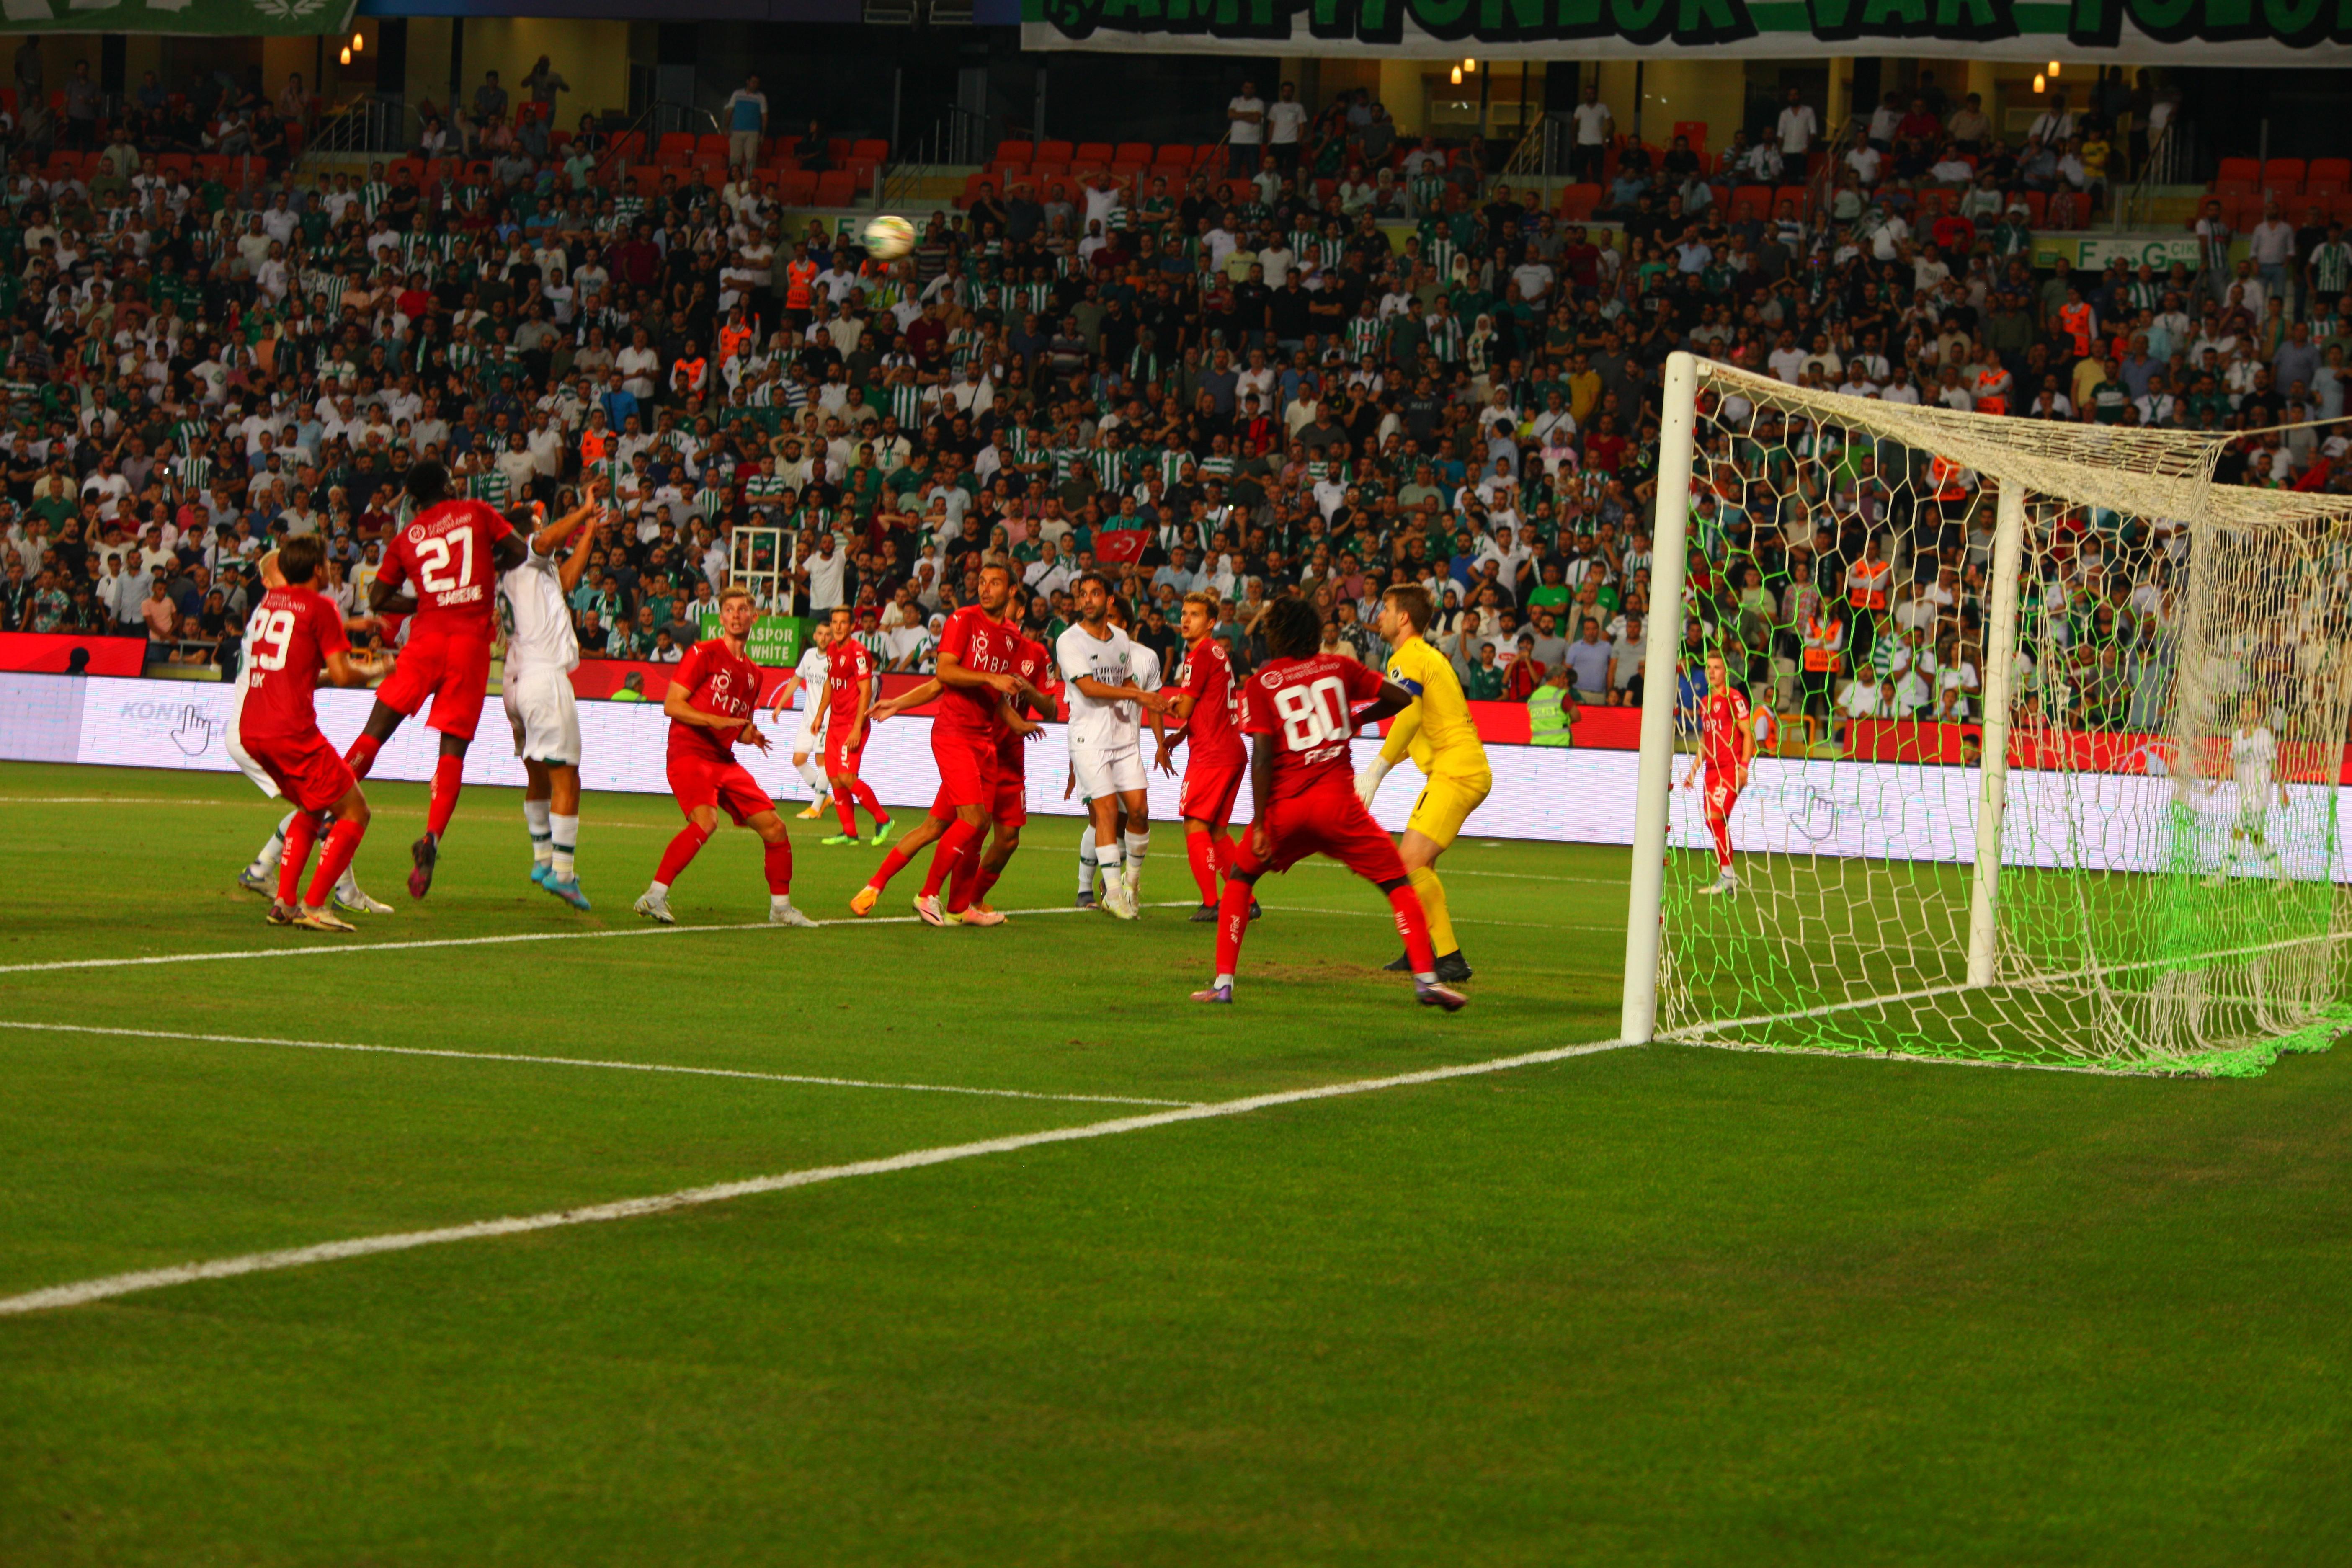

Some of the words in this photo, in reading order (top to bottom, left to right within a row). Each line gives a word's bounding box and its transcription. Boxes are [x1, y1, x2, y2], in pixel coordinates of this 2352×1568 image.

[2079, 242, 2098, 267] F
[2142, 242, 2166, 268] G
[415, 525, 473, 593] 27
[1273, 676, 1353, 752] 80
[841, 744, 848, 761] 9
[1417, 791, 1428, 811] 1
